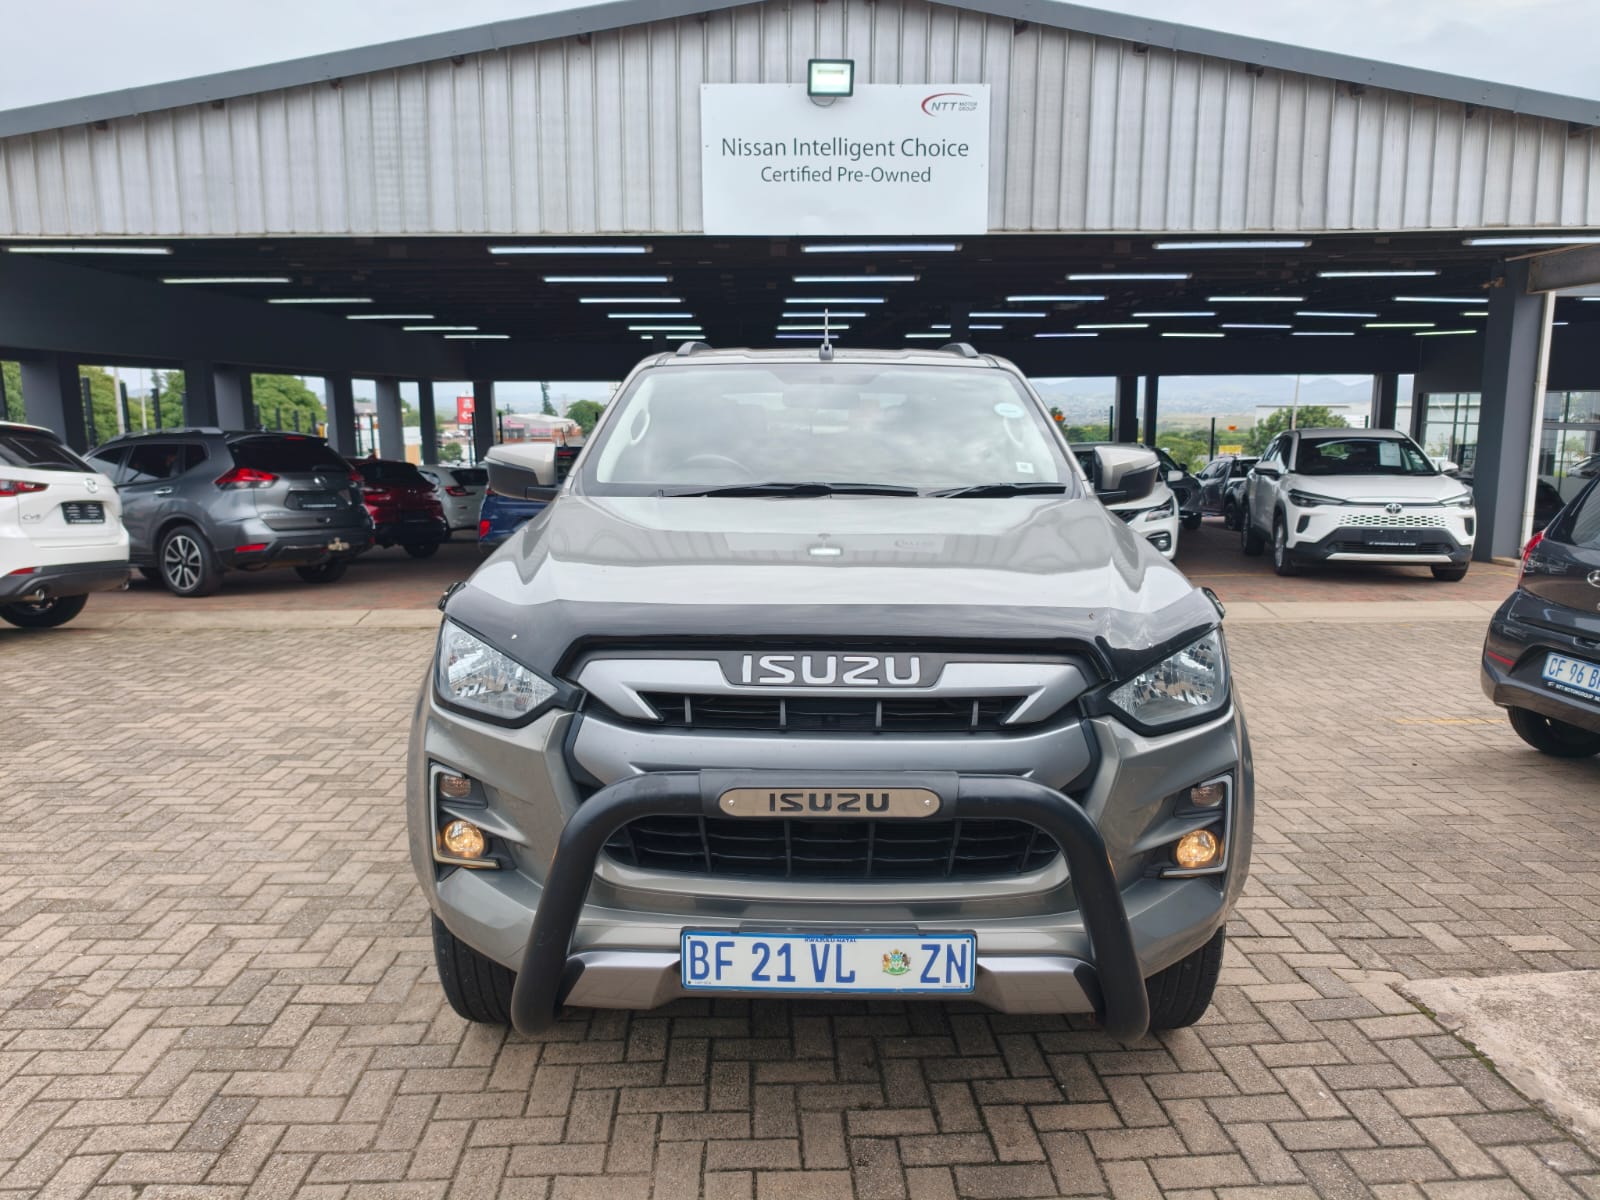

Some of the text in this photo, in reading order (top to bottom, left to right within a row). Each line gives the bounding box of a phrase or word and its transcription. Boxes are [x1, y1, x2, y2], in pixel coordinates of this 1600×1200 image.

[931, 101, 958, 111] NTT
[722, 137, 969, 160] Nissan Intelligent Choice
[761, 166, 931, 183] Certified Pre-Owned
[742, 654, 920, 685] ISUZU
[1548, 658, 1566, 677] CF
[1569, 663, 1584, 683] 96
[769, 793, 890, 812] ISUZU
[689, 940, 967, 984] BF 21 VL ZN
